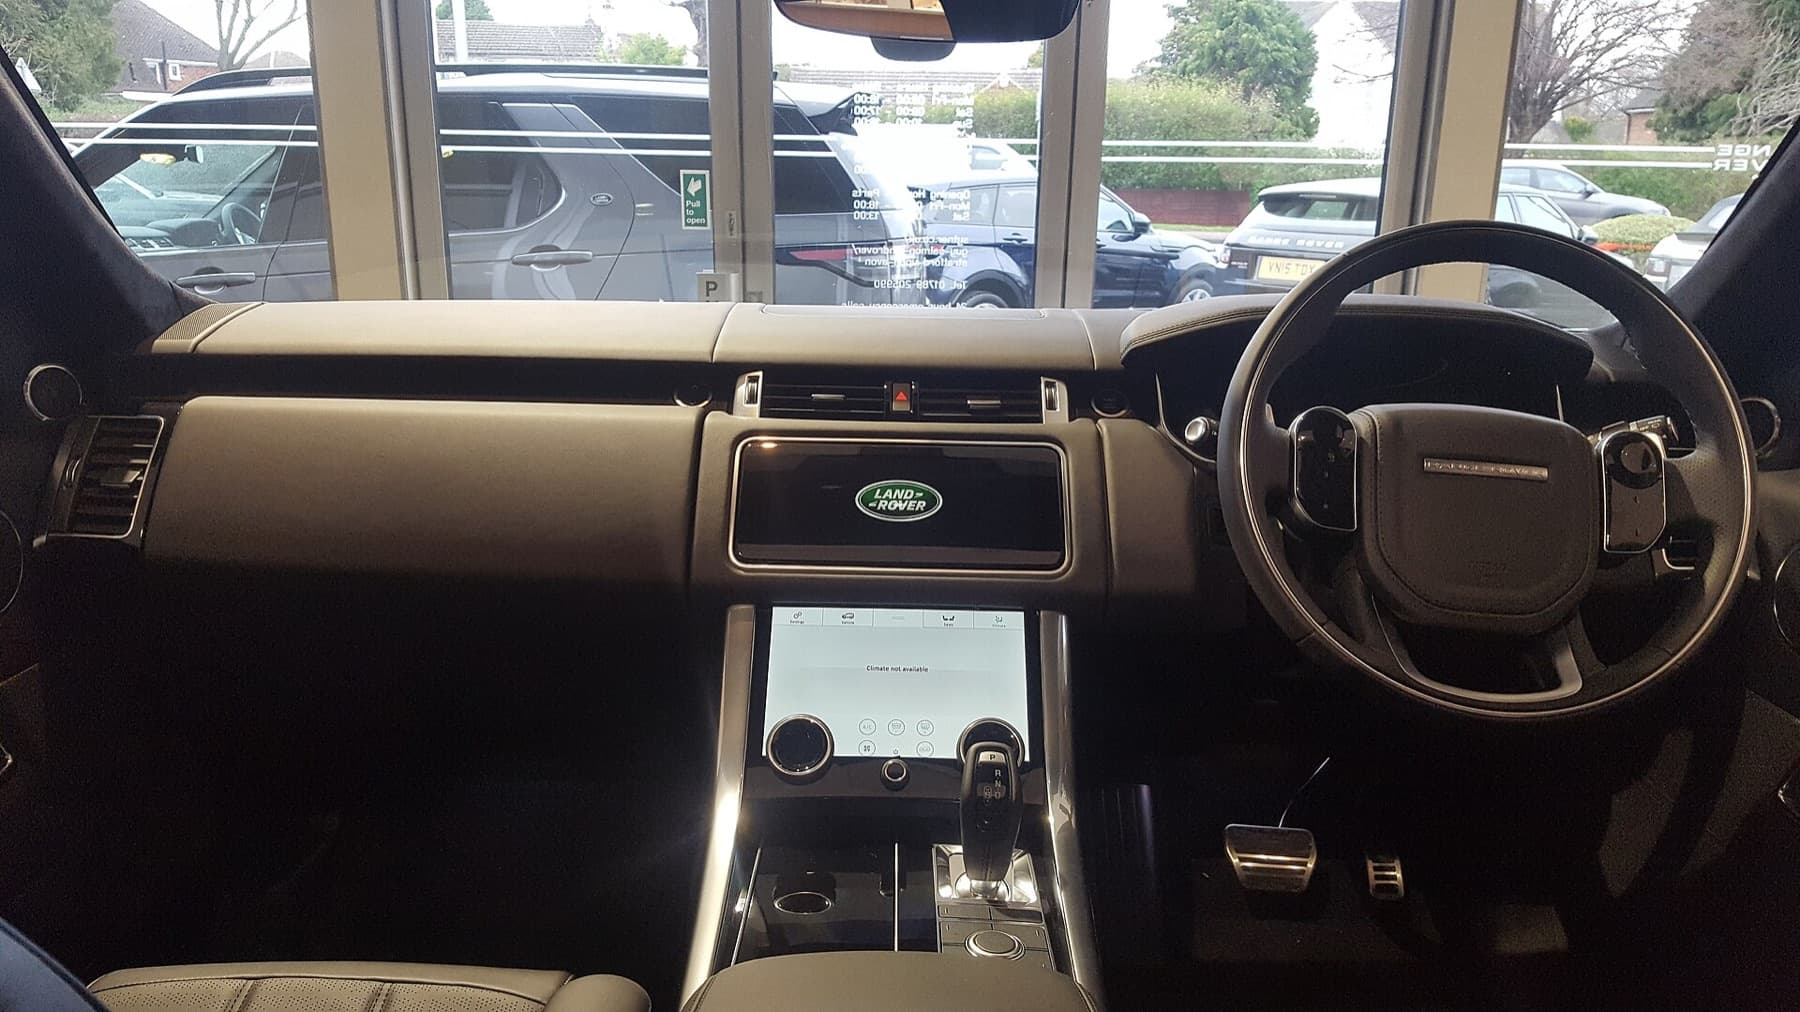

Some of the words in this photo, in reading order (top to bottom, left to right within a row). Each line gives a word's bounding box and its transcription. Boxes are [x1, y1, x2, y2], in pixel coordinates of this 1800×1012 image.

[685, 200, 701, 208] Pull
[686, 217, 706, 225] open
[705, 280, 718, 297] P
[873, 488, 914, 500] LAND
[876, 500, 927, 511] ROVER
[866, 665, 890, 673] Climate
[890, 665, 901, 673] not
[902, 665, 929, 673] available
[989, 753, 996, 761] P
[994, 769, 1001, 777] R
